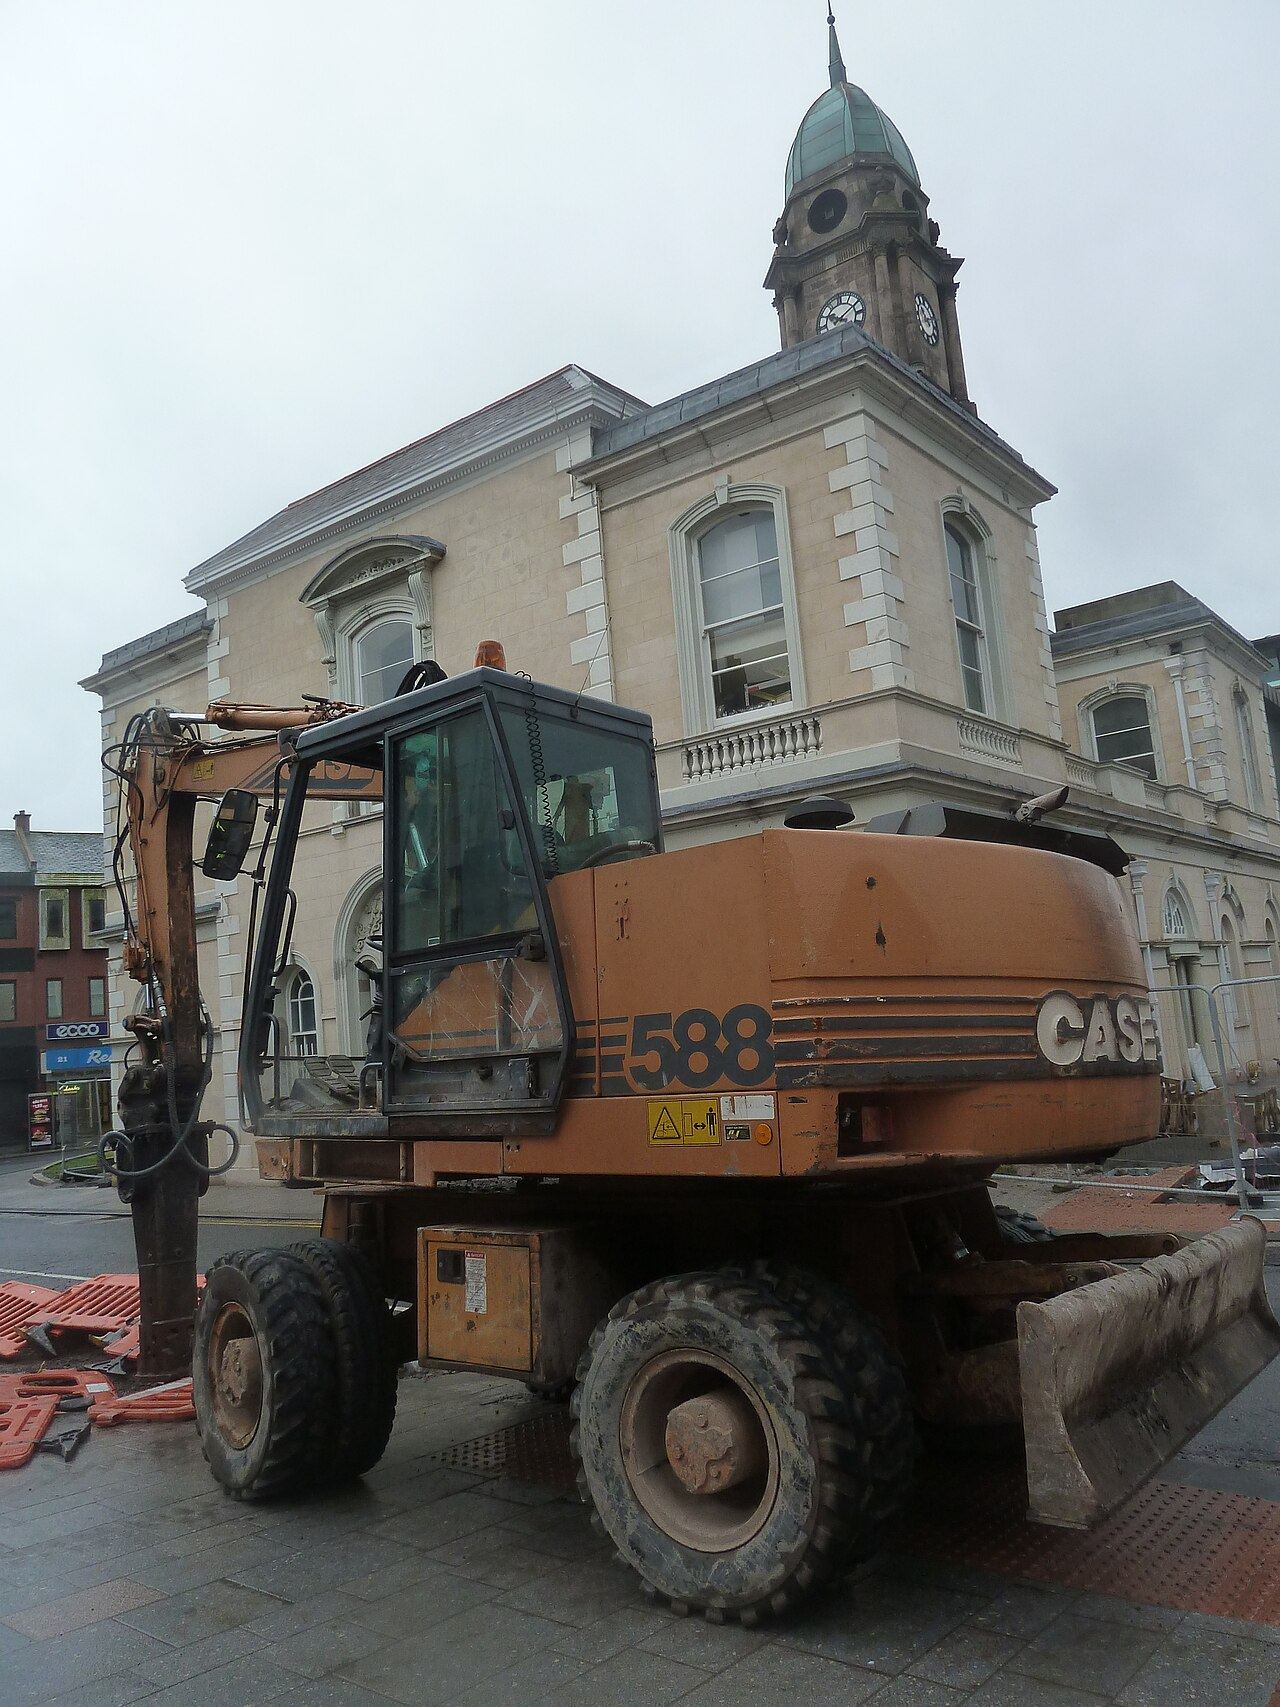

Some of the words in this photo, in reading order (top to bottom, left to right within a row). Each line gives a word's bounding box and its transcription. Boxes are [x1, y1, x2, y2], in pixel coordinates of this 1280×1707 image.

[56, 1024, 100, 1037] ecco
[629, 1003, 775, 1090] 588
[1037, 991, 1158, 1066] CASE
